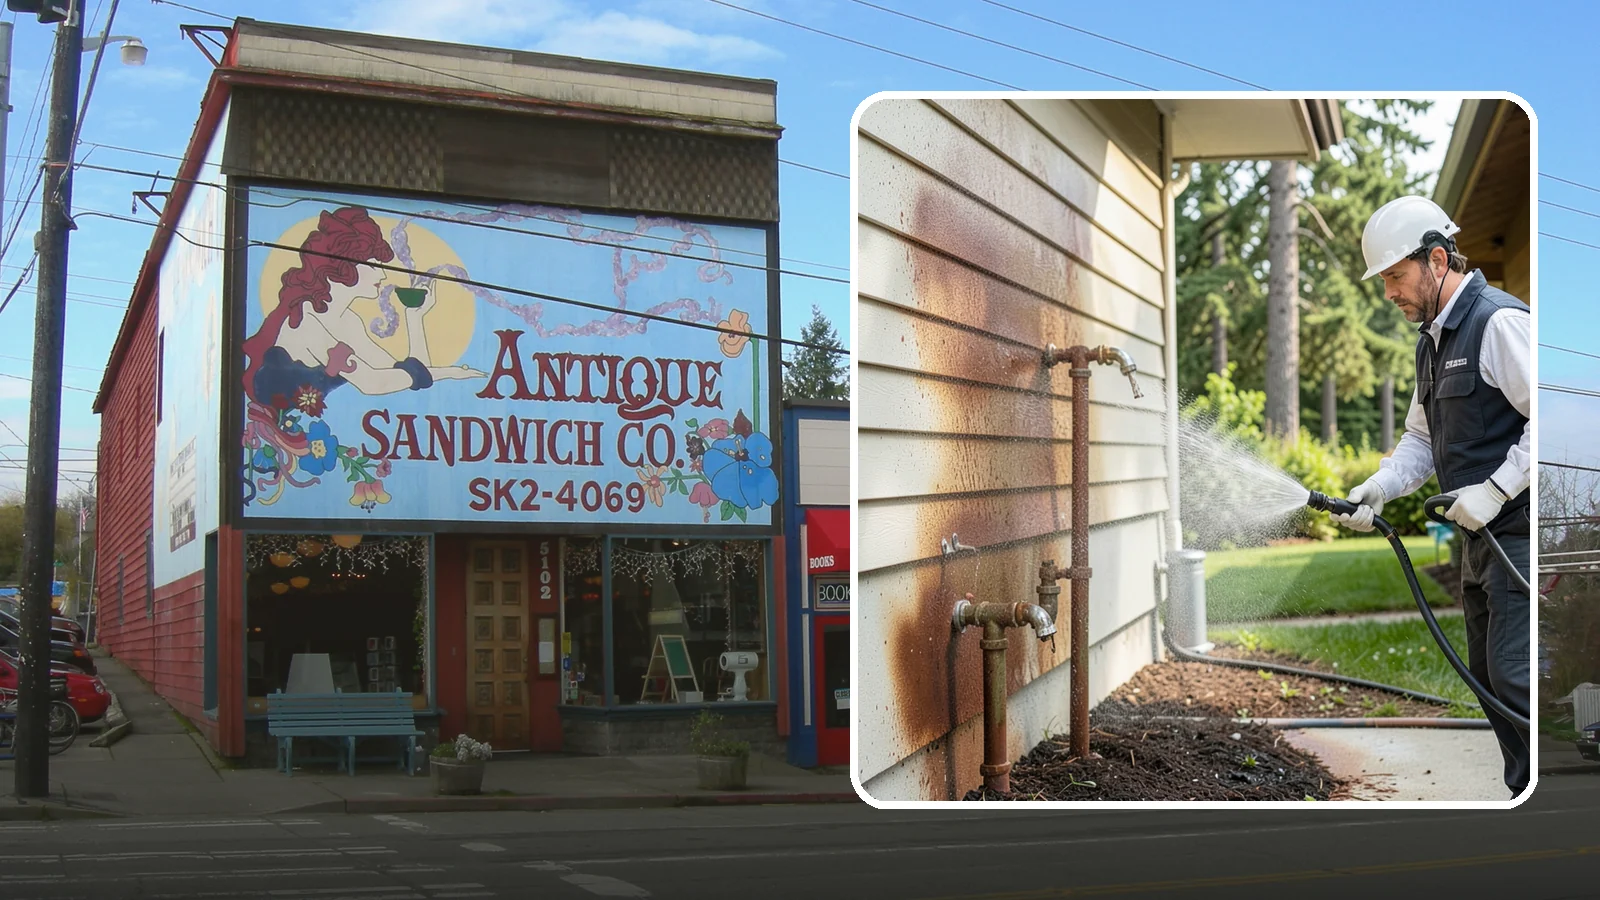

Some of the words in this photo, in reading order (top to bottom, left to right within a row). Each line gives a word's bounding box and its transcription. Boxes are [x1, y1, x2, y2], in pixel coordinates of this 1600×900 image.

[476, 330, 723, 420] ANTIQUE
[361, 409, 604, 467] SANDWICH
[618, 422, 685, 469] CO.
[468, 478, 645, 513] SK2-4069
[540, 541, 551, 600] 5102
[809, 555, 835, 569] BOOKS
